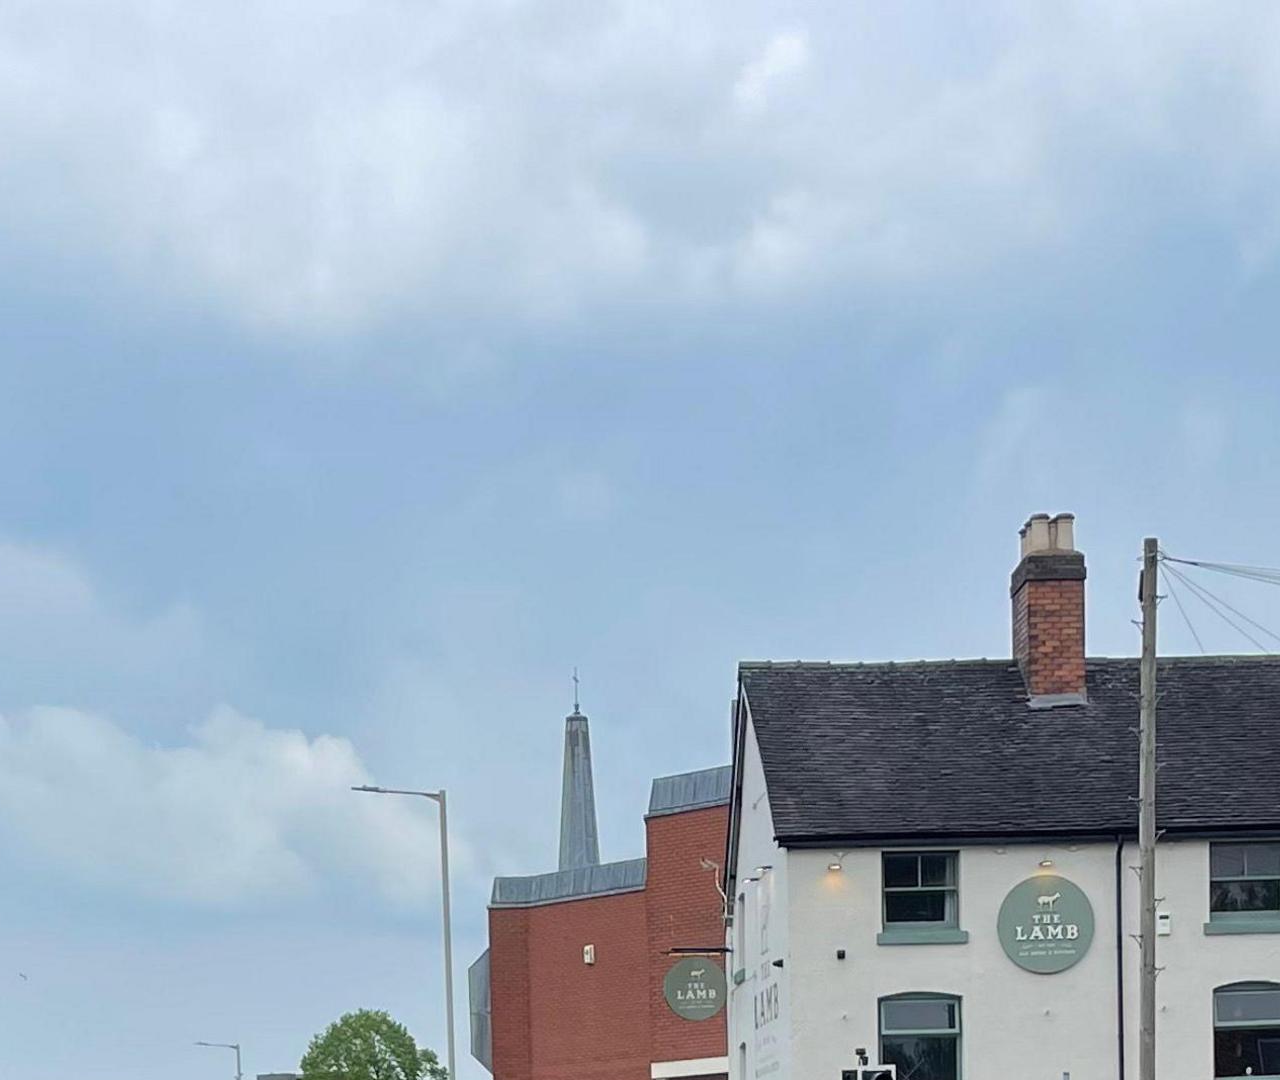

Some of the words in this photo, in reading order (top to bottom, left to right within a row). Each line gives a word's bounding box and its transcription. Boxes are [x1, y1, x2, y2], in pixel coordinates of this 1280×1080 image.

[1032, 914, 1061, 924] THE
[1015, 924, 1079, 941] LAMB
[677, 989, 717, 1000] LAMB
